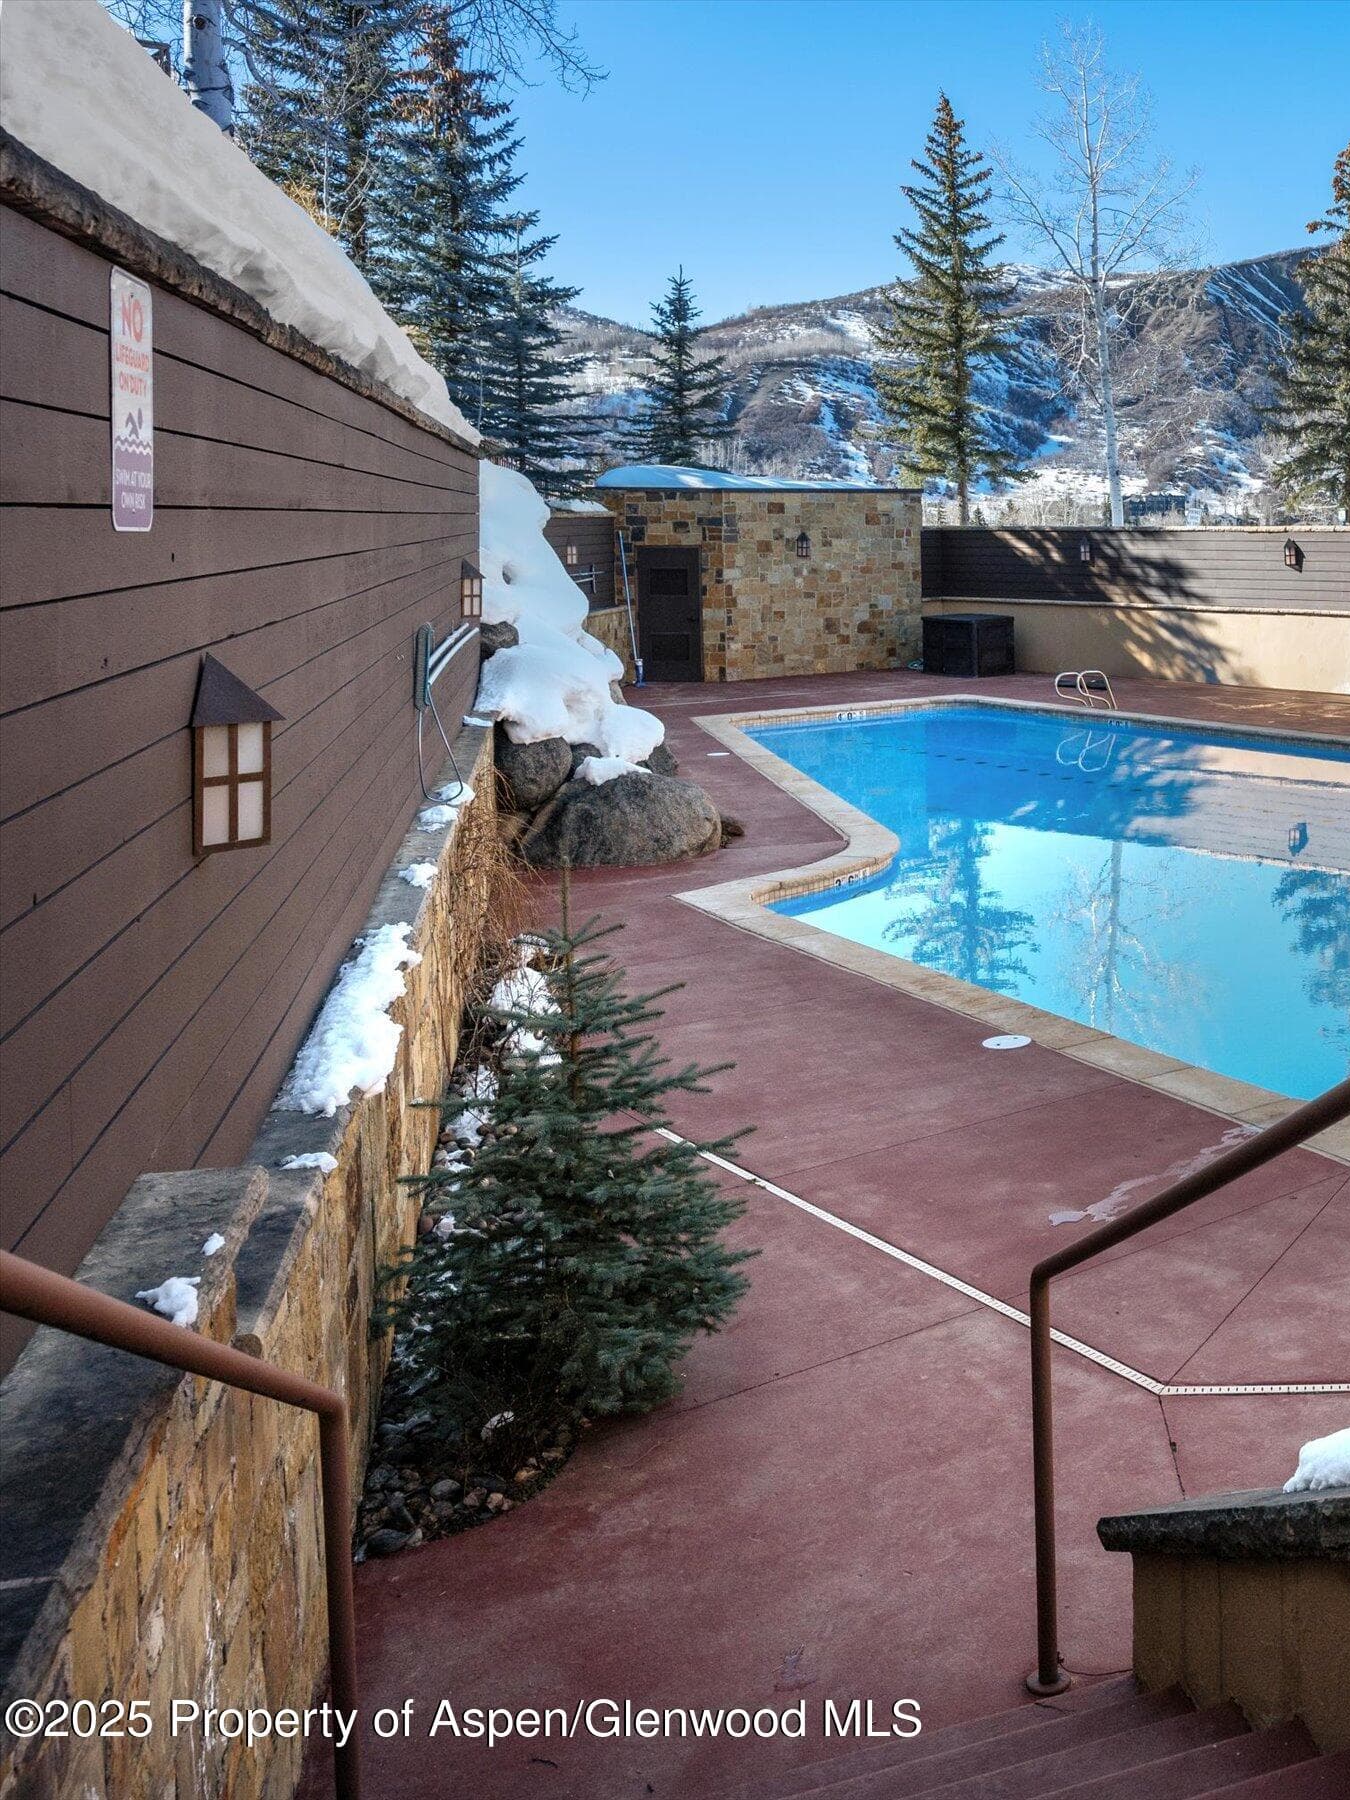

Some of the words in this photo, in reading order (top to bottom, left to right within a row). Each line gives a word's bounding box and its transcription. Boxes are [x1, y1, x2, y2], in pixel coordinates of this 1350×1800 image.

[121, 292, 144, 343] NO
[115, 343, 149, 372] LIFEGUARD
[119, 371, 128, 391] ON
[128, 374, 147, 397] DUTY
[114, 468, 129, 486] SWIM
[138, 472, 152, 489] YOUR
[121, 491, 134, 509] OWN
[134, 493, 146, 510] RISK
